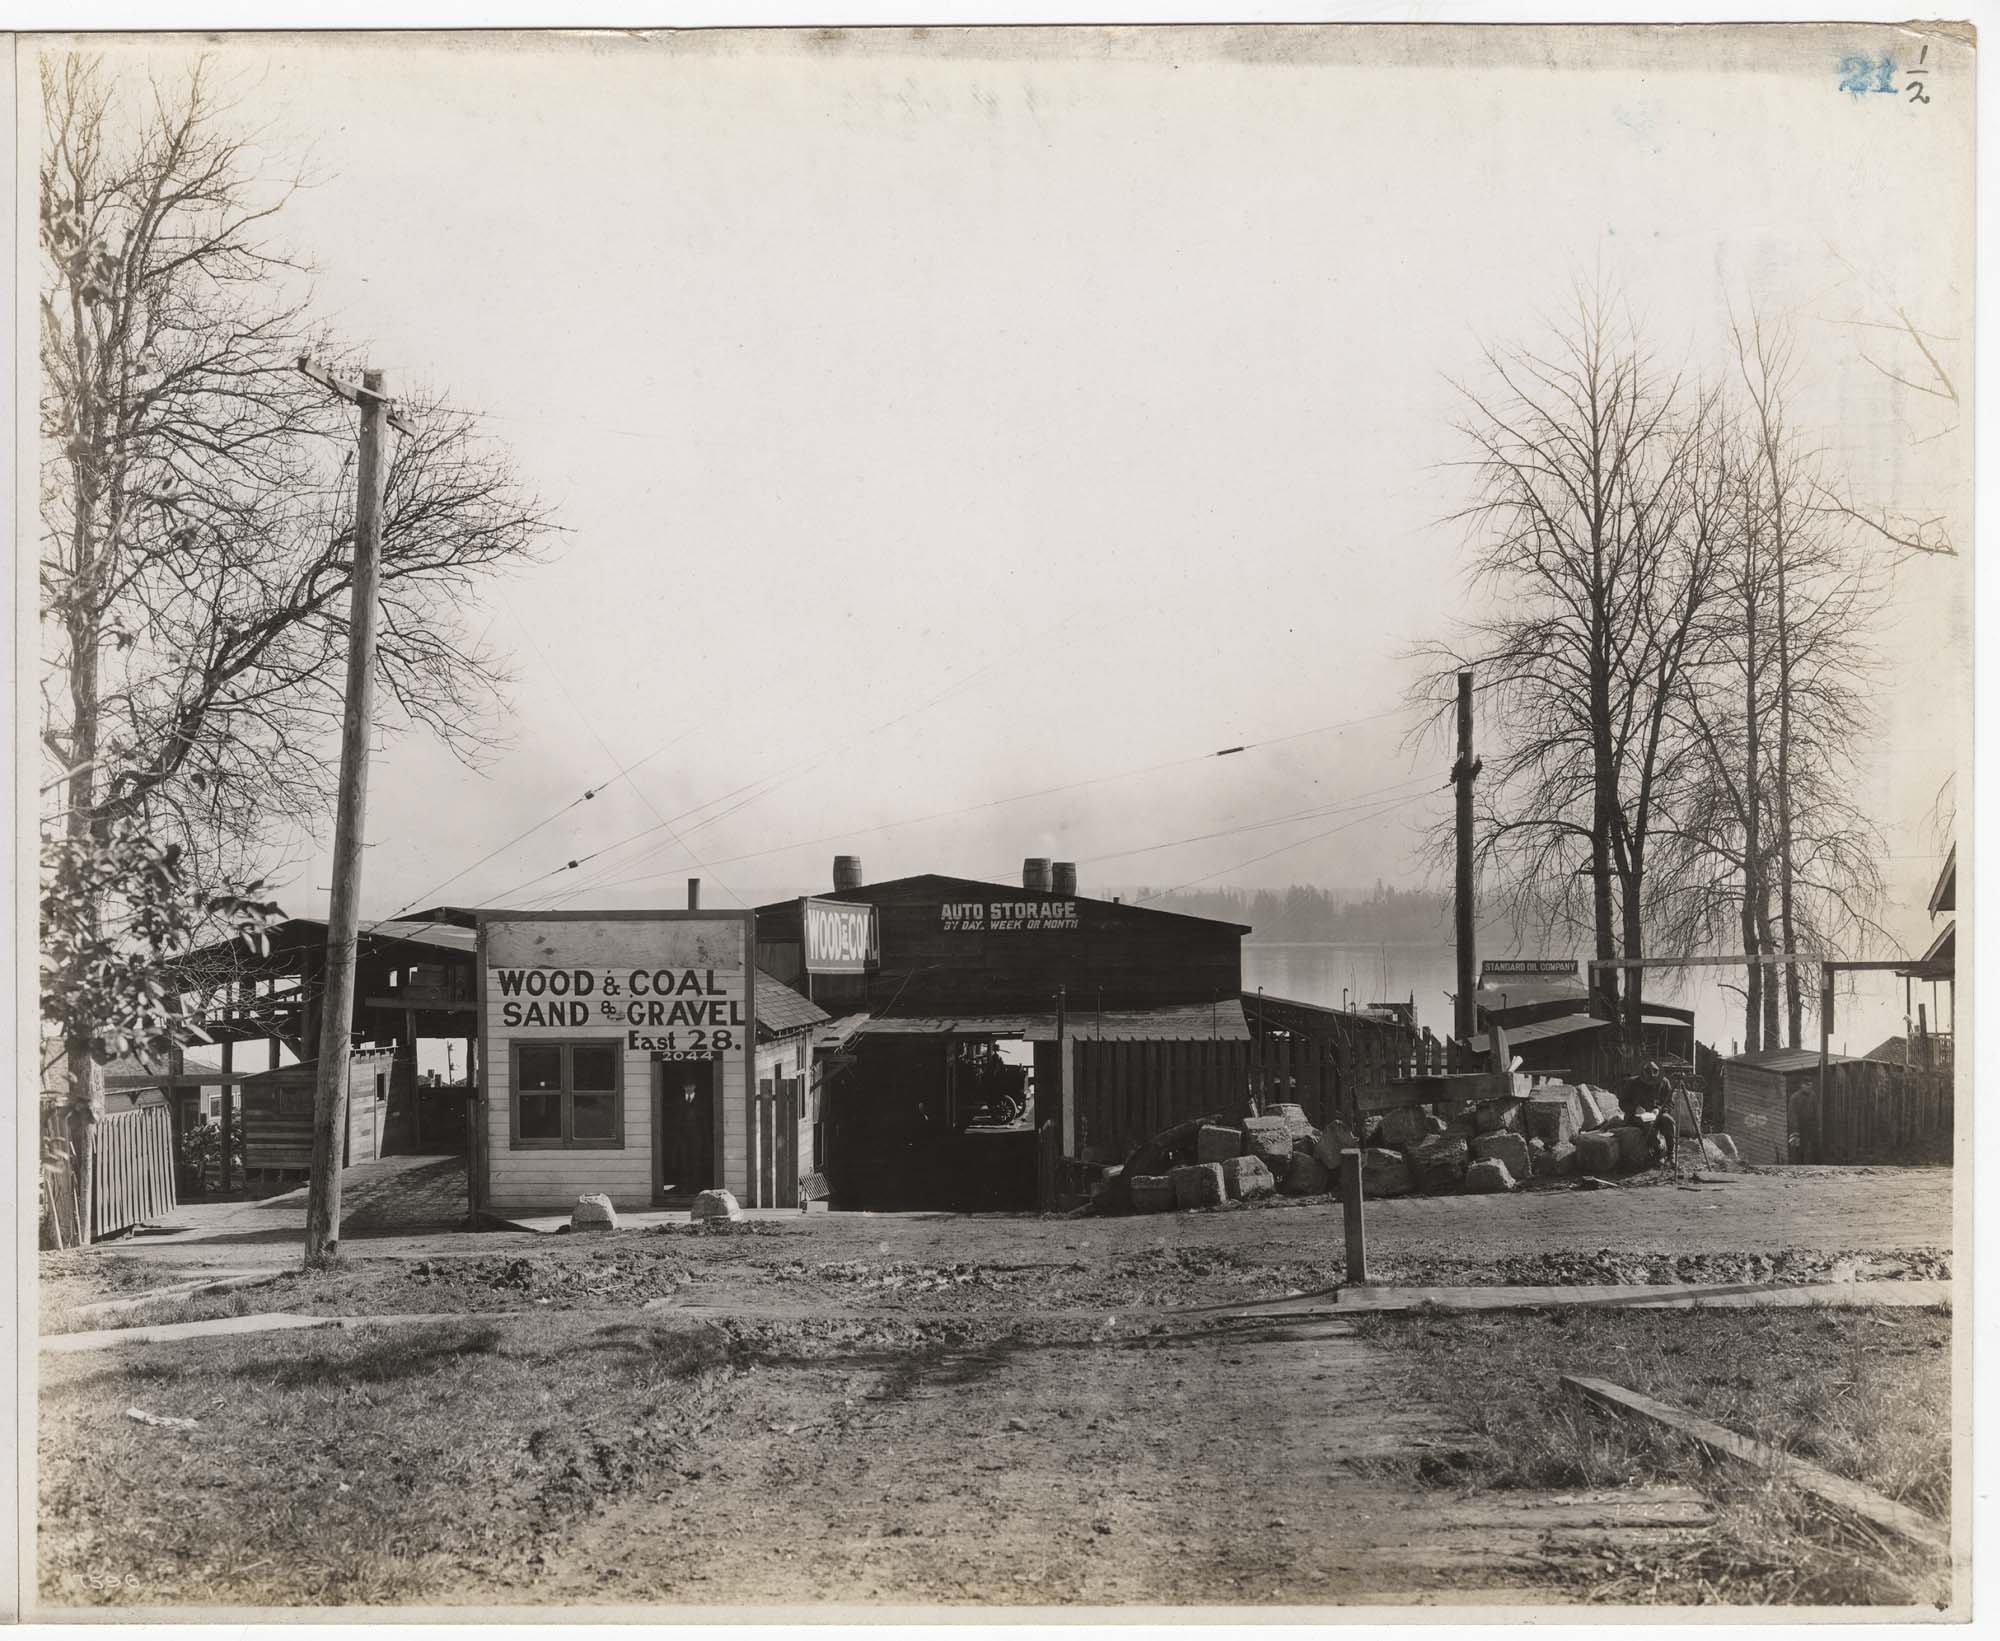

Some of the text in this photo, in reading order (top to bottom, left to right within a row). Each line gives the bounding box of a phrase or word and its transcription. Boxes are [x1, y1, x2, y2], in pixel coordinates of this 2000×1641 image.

[941, 901, 1077, 920] AUTO STORAGE
[807, 909, 841, 959] WOOD
[848, 913, 878, 960] COAL
[943, 921, 959, 930] BY
[990, 920, 1022, 930] WEEK
[1027, 920, 1041, 930] OR
[1043, 919, 1079, 929] MONTH
[1485, 962, 1576, 972] STANDARD OIL COMPANY
[498, 969, 727, 997] WOOD & COAL
[502, 1001, 590, 1027] SAND
[626, 1000, 746, 1027] GRAVEL
[628, 1029, 742, 1051] East 28.
[662, 1051, 714, 1062] 2044
